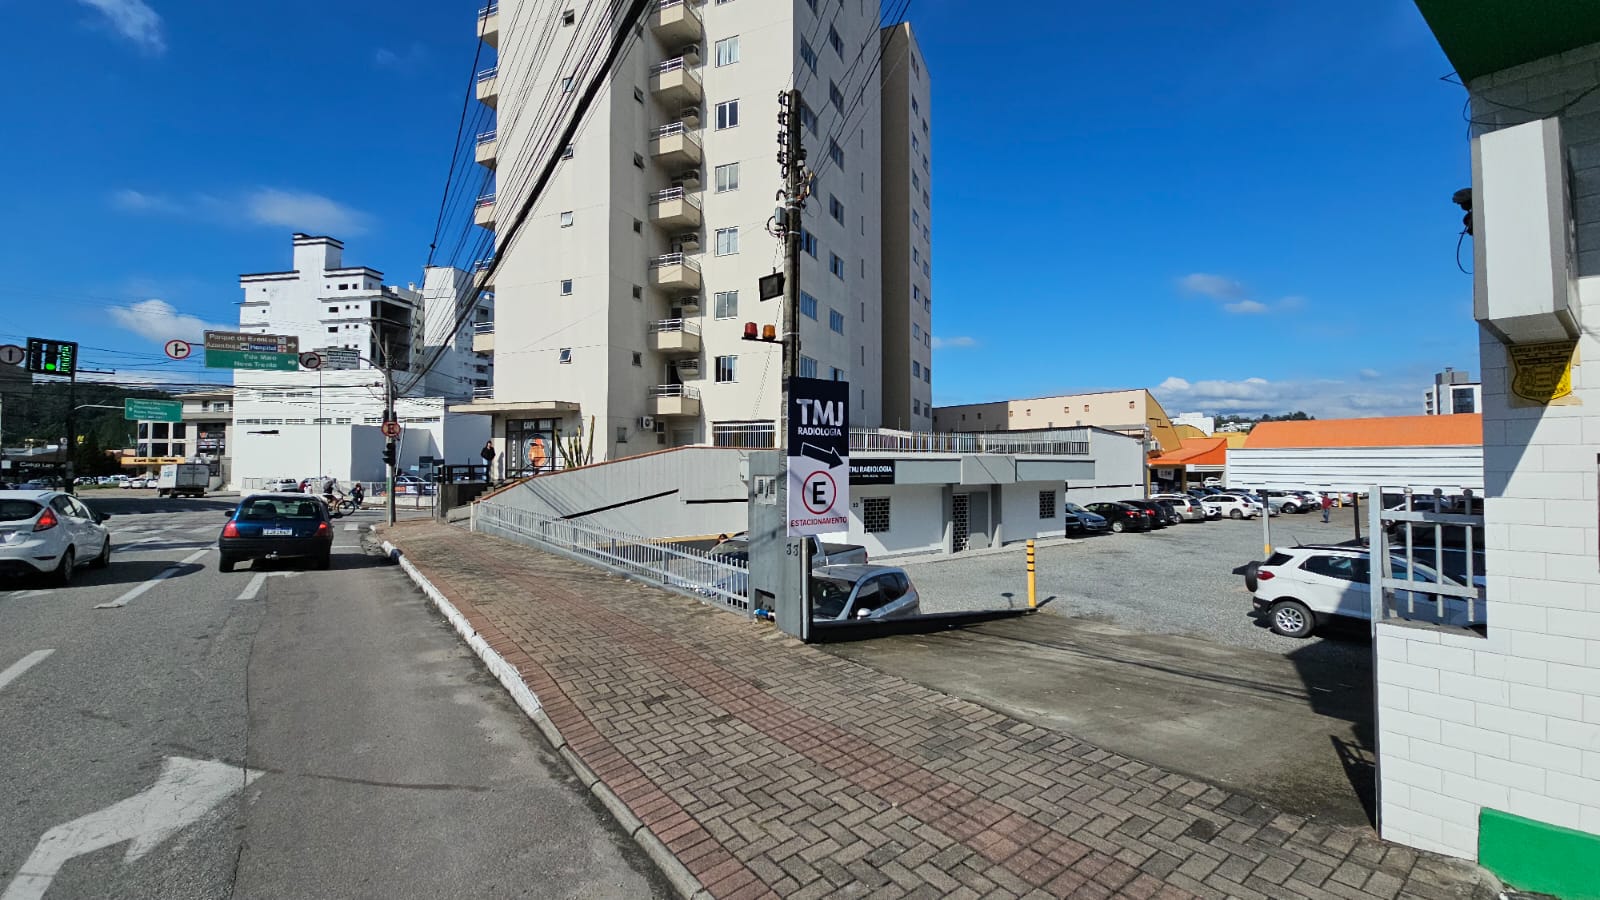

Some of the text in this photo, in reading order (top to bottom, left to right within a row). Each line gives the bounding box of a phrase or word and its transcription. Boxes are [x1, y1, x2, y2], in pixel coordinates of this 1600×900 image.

[209, 334, 235, 342] Parque
[795, 398, 844, 427] TMJ
[797, 426, 842, 437] RADIOLOGIA
[860, 465, 893, 473] RADIOLOGIA
[812, 481, 826, 504] E
[791, 516, 848, 527] ESTACIONAMENTO
[786, 543, 799, 557] 33
